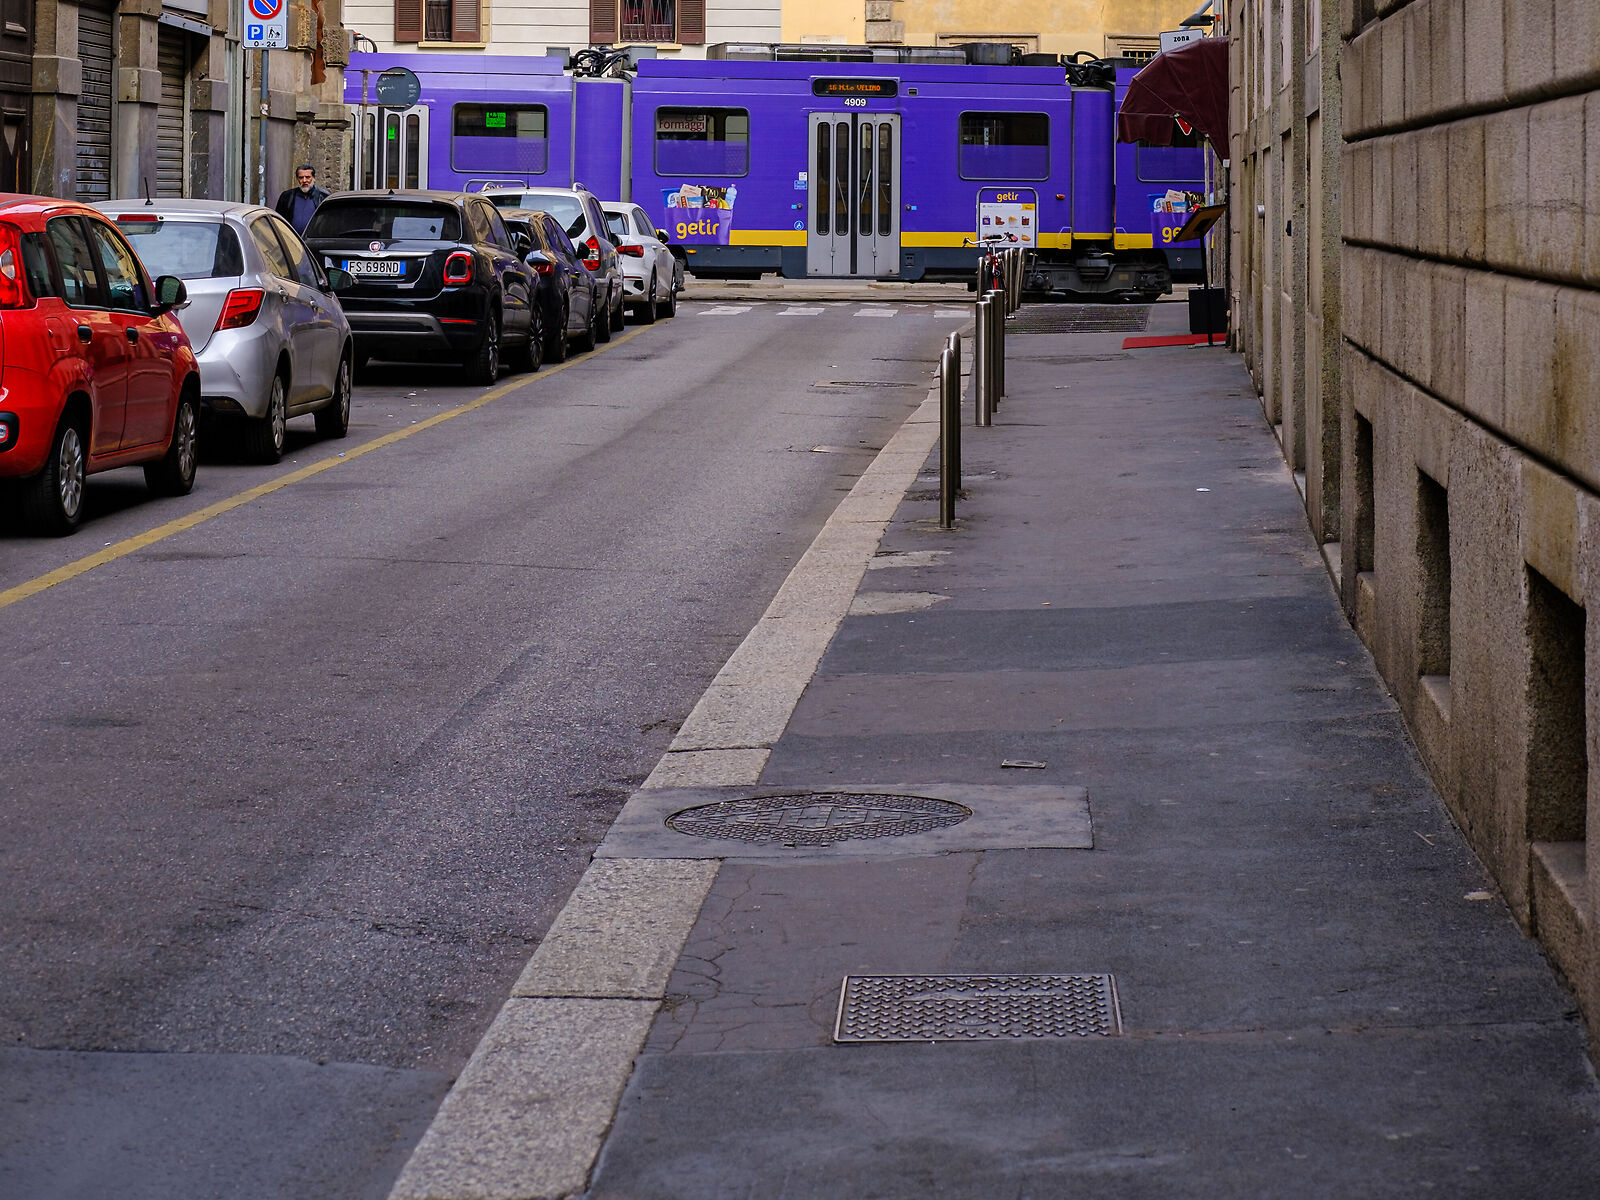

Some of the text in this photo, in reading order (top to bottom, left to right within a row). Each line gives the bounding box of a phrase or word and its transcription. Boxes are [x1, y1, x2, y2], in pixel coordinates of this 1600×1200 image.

[251, 26, 260, 38] P
[1173, 35, 1190, 43] zona
[844, 98, 867, 107] 4909
[659, 119, 705, 132] Formaggi
[996, 192, 1019, 203] getir
[676, 219, 720, 240] getir
[1162, 226, 1183, 243] ge
[349, 261, 399, 273] FS 698ND
